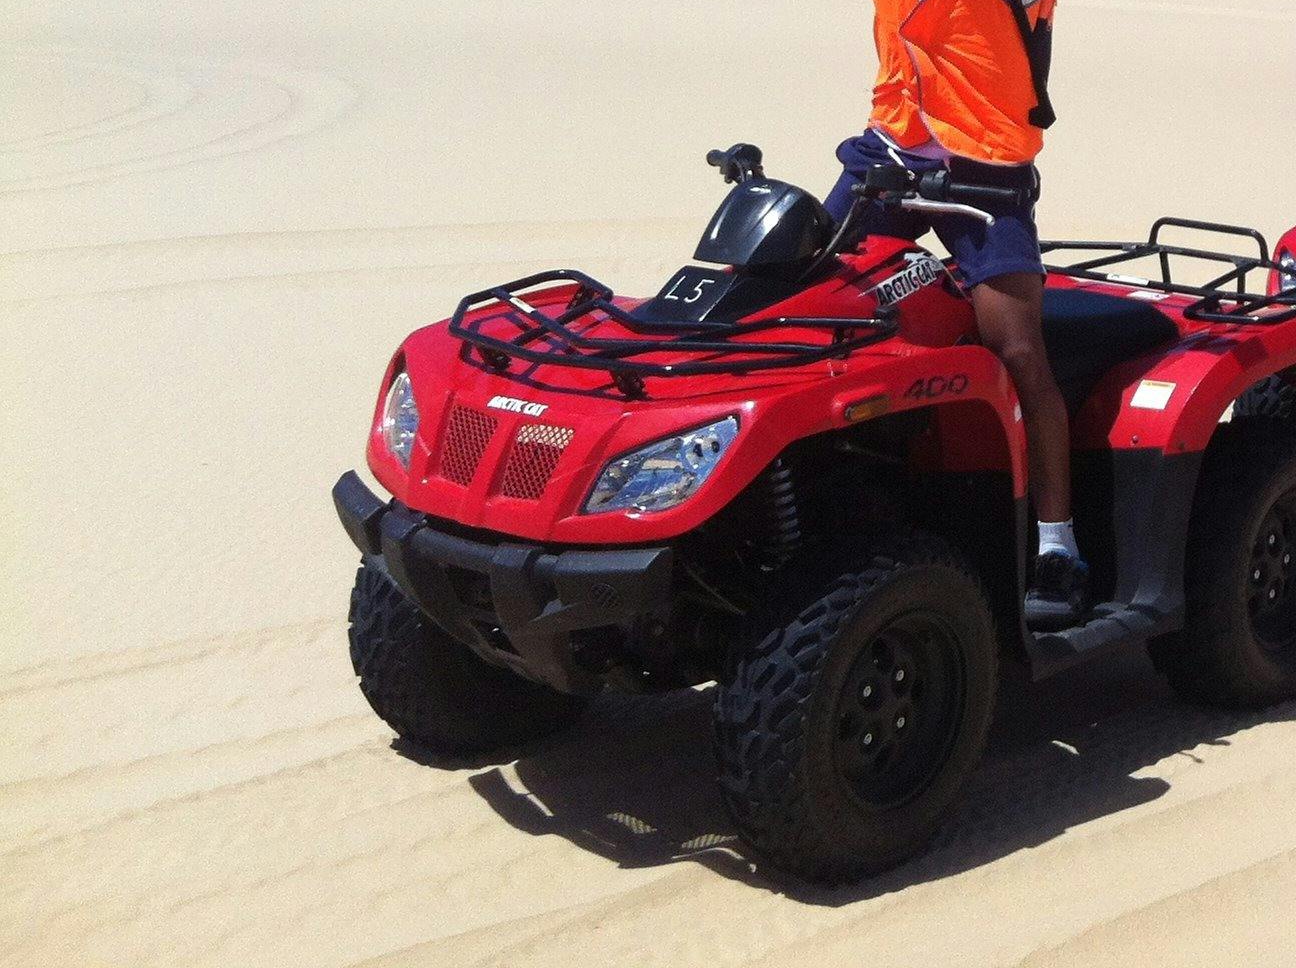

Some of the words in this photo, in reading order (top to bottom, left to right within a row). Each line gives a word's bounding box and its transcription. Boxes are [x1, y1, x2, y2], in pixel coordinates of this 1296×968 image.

[664, 275, 715, 303] L5
[877, 270, 920, 306] ARCTIC
[915, 260, 937, 284] CAT
[903, 374, 969, 399] 400
[486, 395, 529, 413] ARCTIC
[522, 402, 549, 417] CAT
